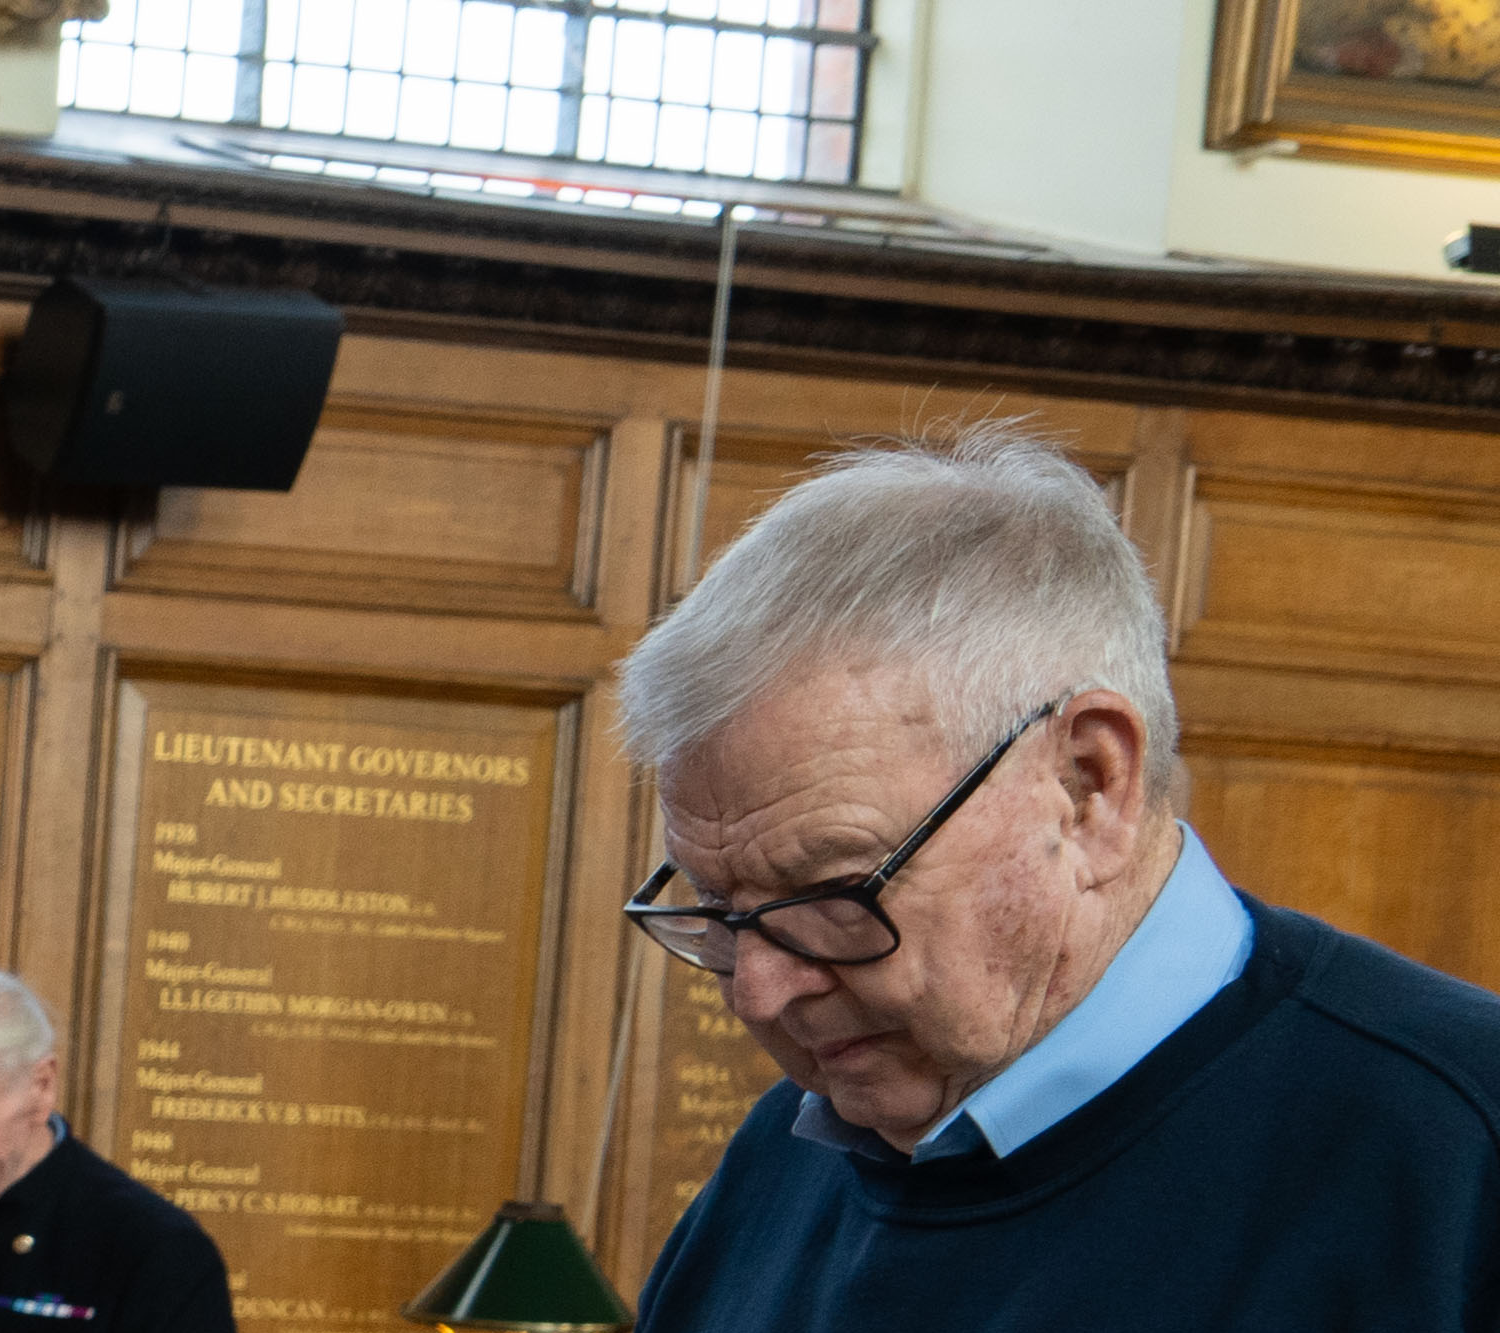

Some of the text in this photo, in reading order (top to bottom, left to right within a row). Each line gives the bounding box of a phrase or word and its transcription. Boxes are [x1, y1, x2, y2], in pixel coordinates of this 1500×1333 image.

[153, 731, 531, 787] LIEUTENANT GOVERNORS
[205, 778, 474, 824] AND SECRETARIES
